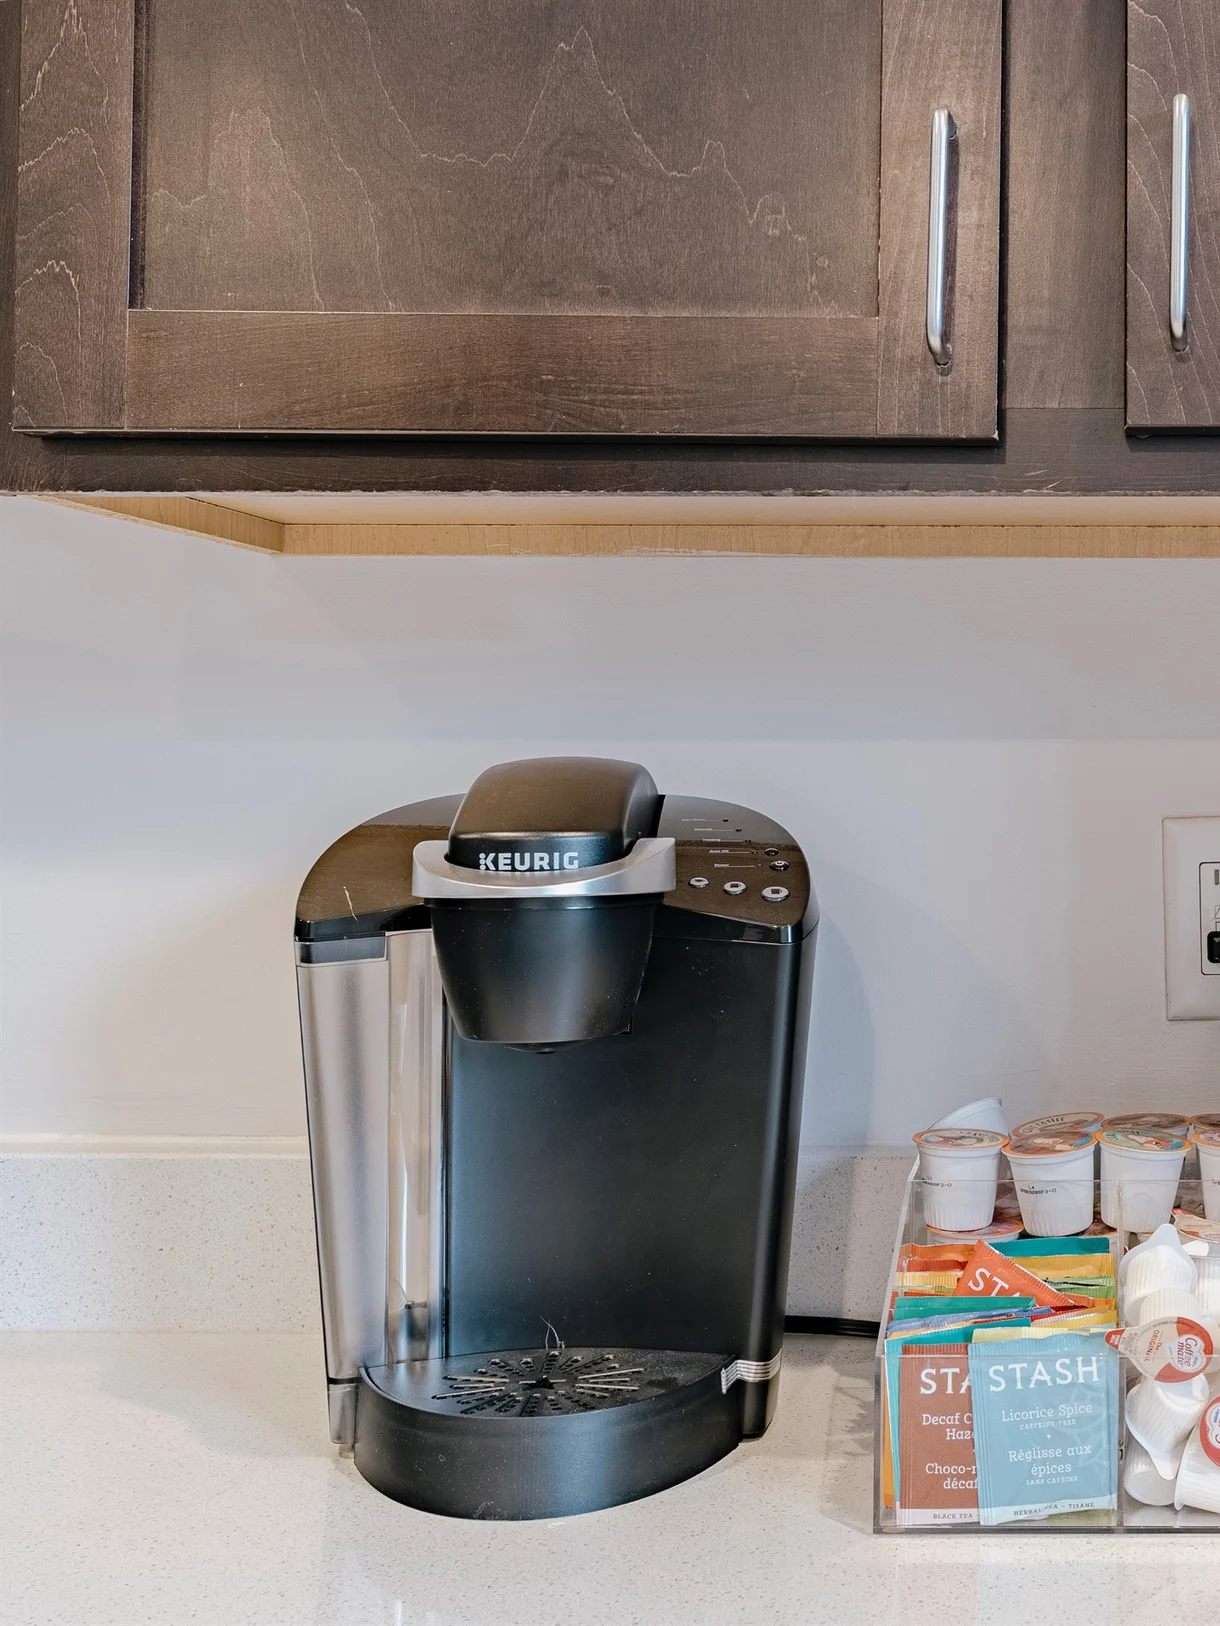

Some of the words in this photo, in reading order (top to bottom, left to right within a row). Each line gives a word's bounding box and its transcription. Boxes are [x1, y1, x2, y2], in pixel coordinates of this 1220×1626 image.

[479, 851, 579, 871] KEURIG
[967, 1267, 1020, 1297] ST
[1176, 1341, 1184, 1366] mate
[1184, 1337, 1198, 1367] Coffee
[988, 1356, 1100, 1392] STASH
[922, 1413, 961, 1426] Decaf
[1001, 1407, 1055, 1423] Licorice
[1058, 1404, 1093, 1418] Spice
[1008, 1447, 1063, 1464] Réglisse
[1066, 1444, 1092, 1457] aux
[1031, 1463, 1072, 1477] épices
[1026, 1478, 1045, 1486] SANS
[1068, 1502, 1095, 1510] TISANE
